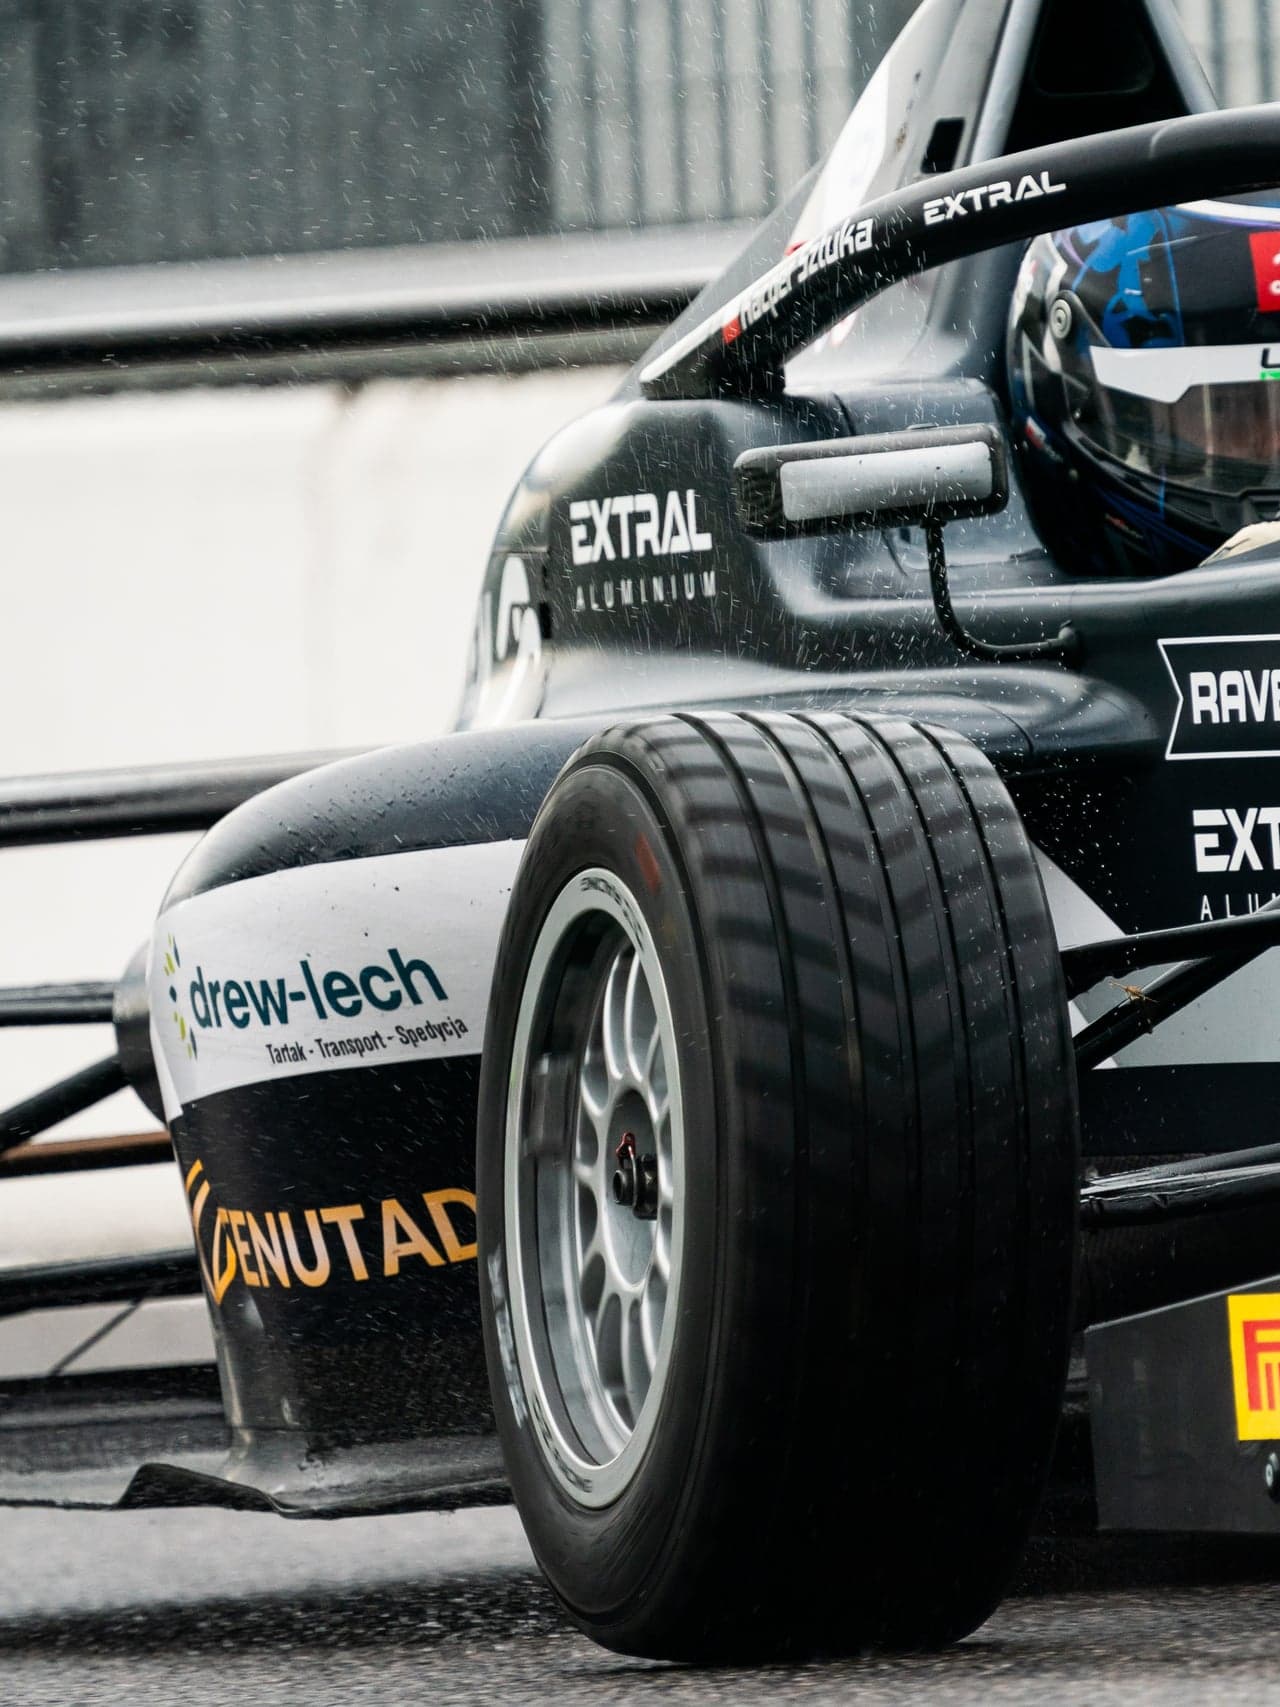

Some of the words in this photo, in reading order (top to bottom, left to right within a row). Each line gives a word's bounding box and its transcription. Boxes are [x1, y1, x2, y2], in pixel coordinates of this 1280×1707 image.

[922, 170, 1067, 226] EXTRAL
[569, 488, 713, 566] EXTRAL
[575, 570, 717, 611] ALUMINIUM
[189, 947, 449, 1029] drew-lech
[265, 1041, 307, 1066] Tartak
[315, 1027, 387, 1059] Transport
[397, 1016, 469, 1048] Spedycja
